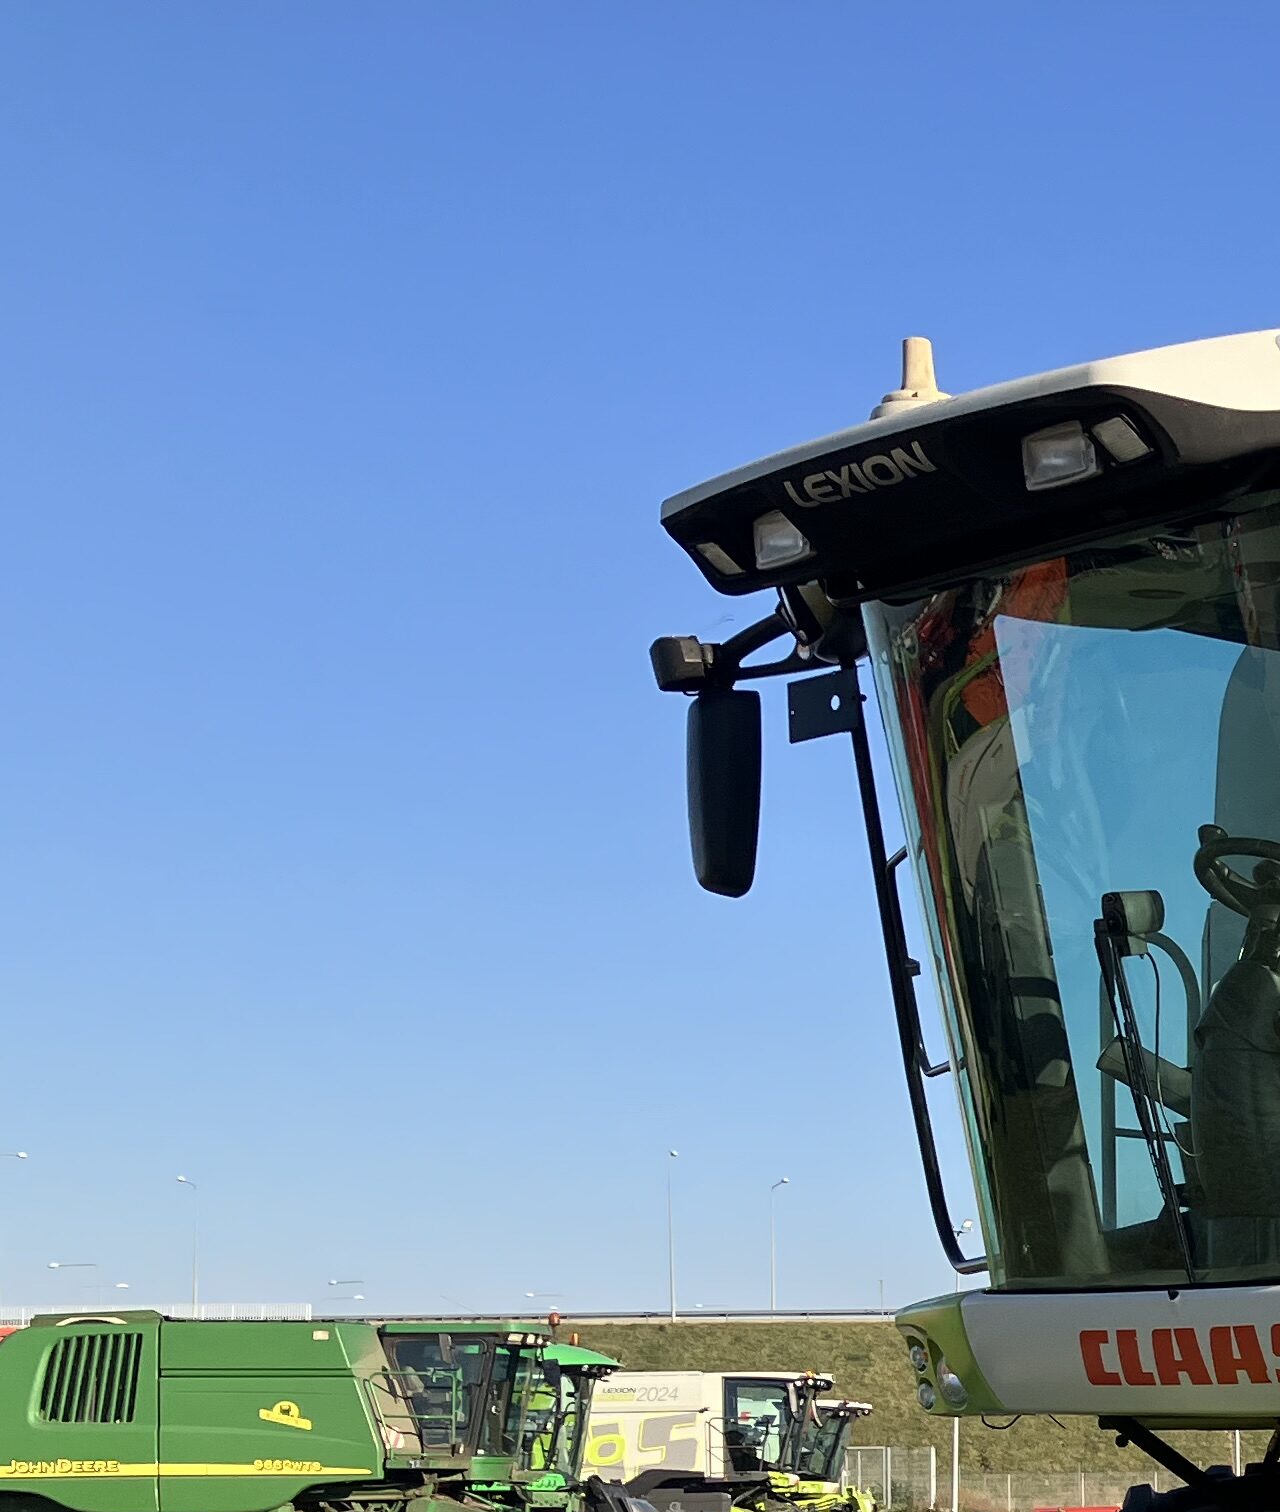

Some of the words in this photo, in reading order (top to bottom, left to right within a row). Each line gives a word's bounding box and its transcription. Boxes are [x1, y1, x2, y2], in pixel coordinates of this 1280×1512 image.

[783, 440, 938, 509] LEXION
[636, 1386, 679, 1402] 2024
[6, 1459, 56, 1475] JOHN
[56, 1458, 120, 1474] DEERE
